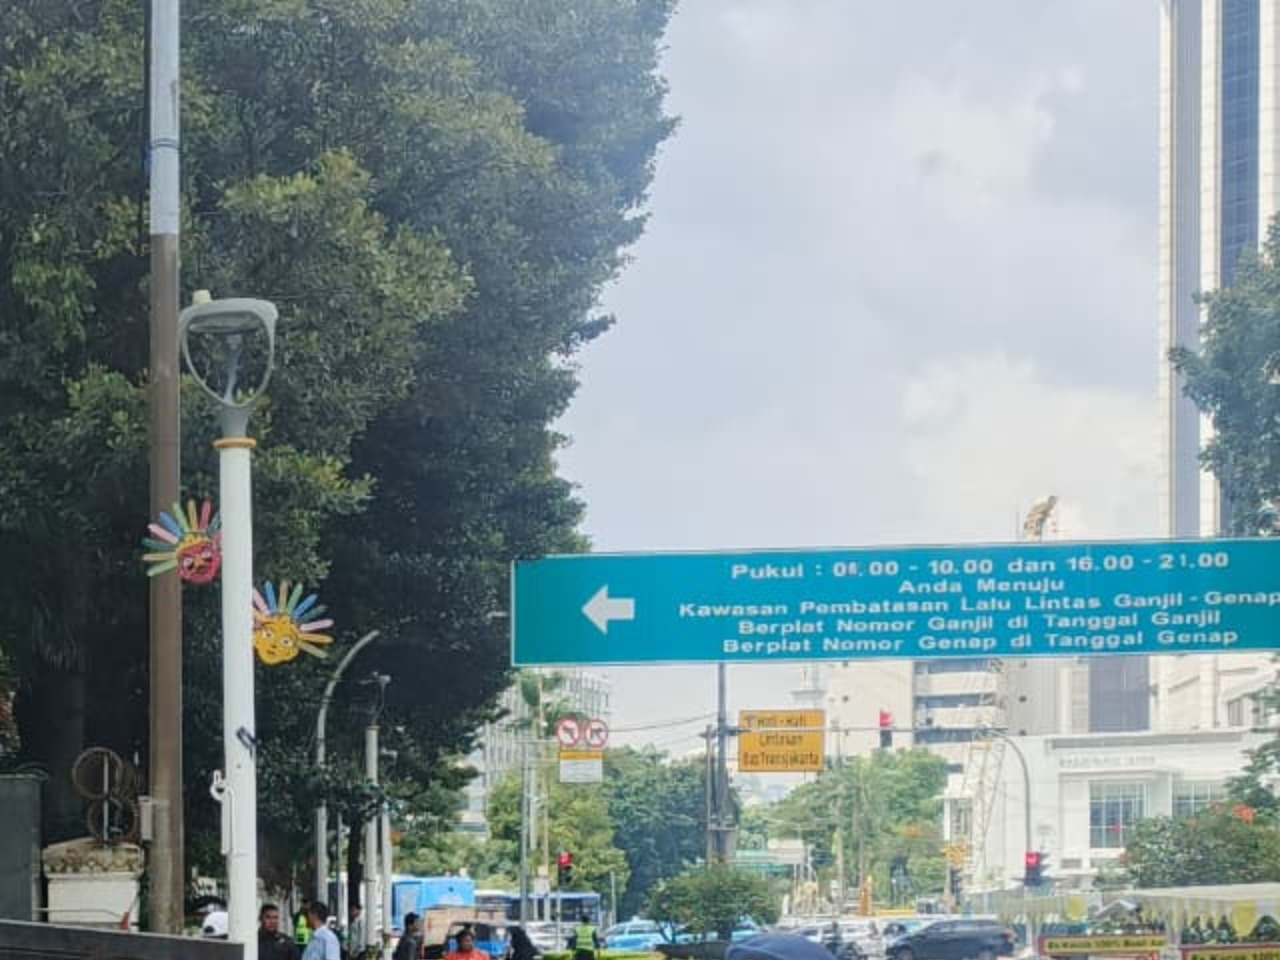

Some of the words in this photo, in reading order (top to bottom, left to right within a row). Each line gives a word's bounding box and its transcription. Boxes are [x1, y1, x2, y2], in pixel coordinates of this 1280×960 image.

[731, 563, 803, 579] Pukul
[928, 559, 994, 576] 10.00
[1007, 557, 1056, 573] dan
[1158, 552, 1229, 570] 21.00
[899, 579, 962, 594] Anda
[977, 577, 1065, 593] Menuju
[679, 602, 788, 617] Kawasan
[800, 598, 948, 615] Pembatasan
[961, 596, 1012, 612] Lalu
[1025, 595, 1101, 610] Lintas
[1113, 593, 1183, 609] Ganjil
[1203, 590, 1280, 607] Genap
[738, 618, 824, 636] Berplat
[836, 617, 915, 633] Nomor
[928, 615, 993, 632] Ganjil
[1007, 614, 1028, 629] di
[1043, 613, 1138, 631] Tanggal
[1151, 610, 1221, 628] Ganjil
[723, 637, 813, 655] Berplat
[823, 635, 904, 652] Nomor
[918, 634, 997, 651] Genap
[1010, 633, 1032, 648] di
[1045, 631, 1143, 649] Tanggal
[1157, 628, 1239, 646] Genap
